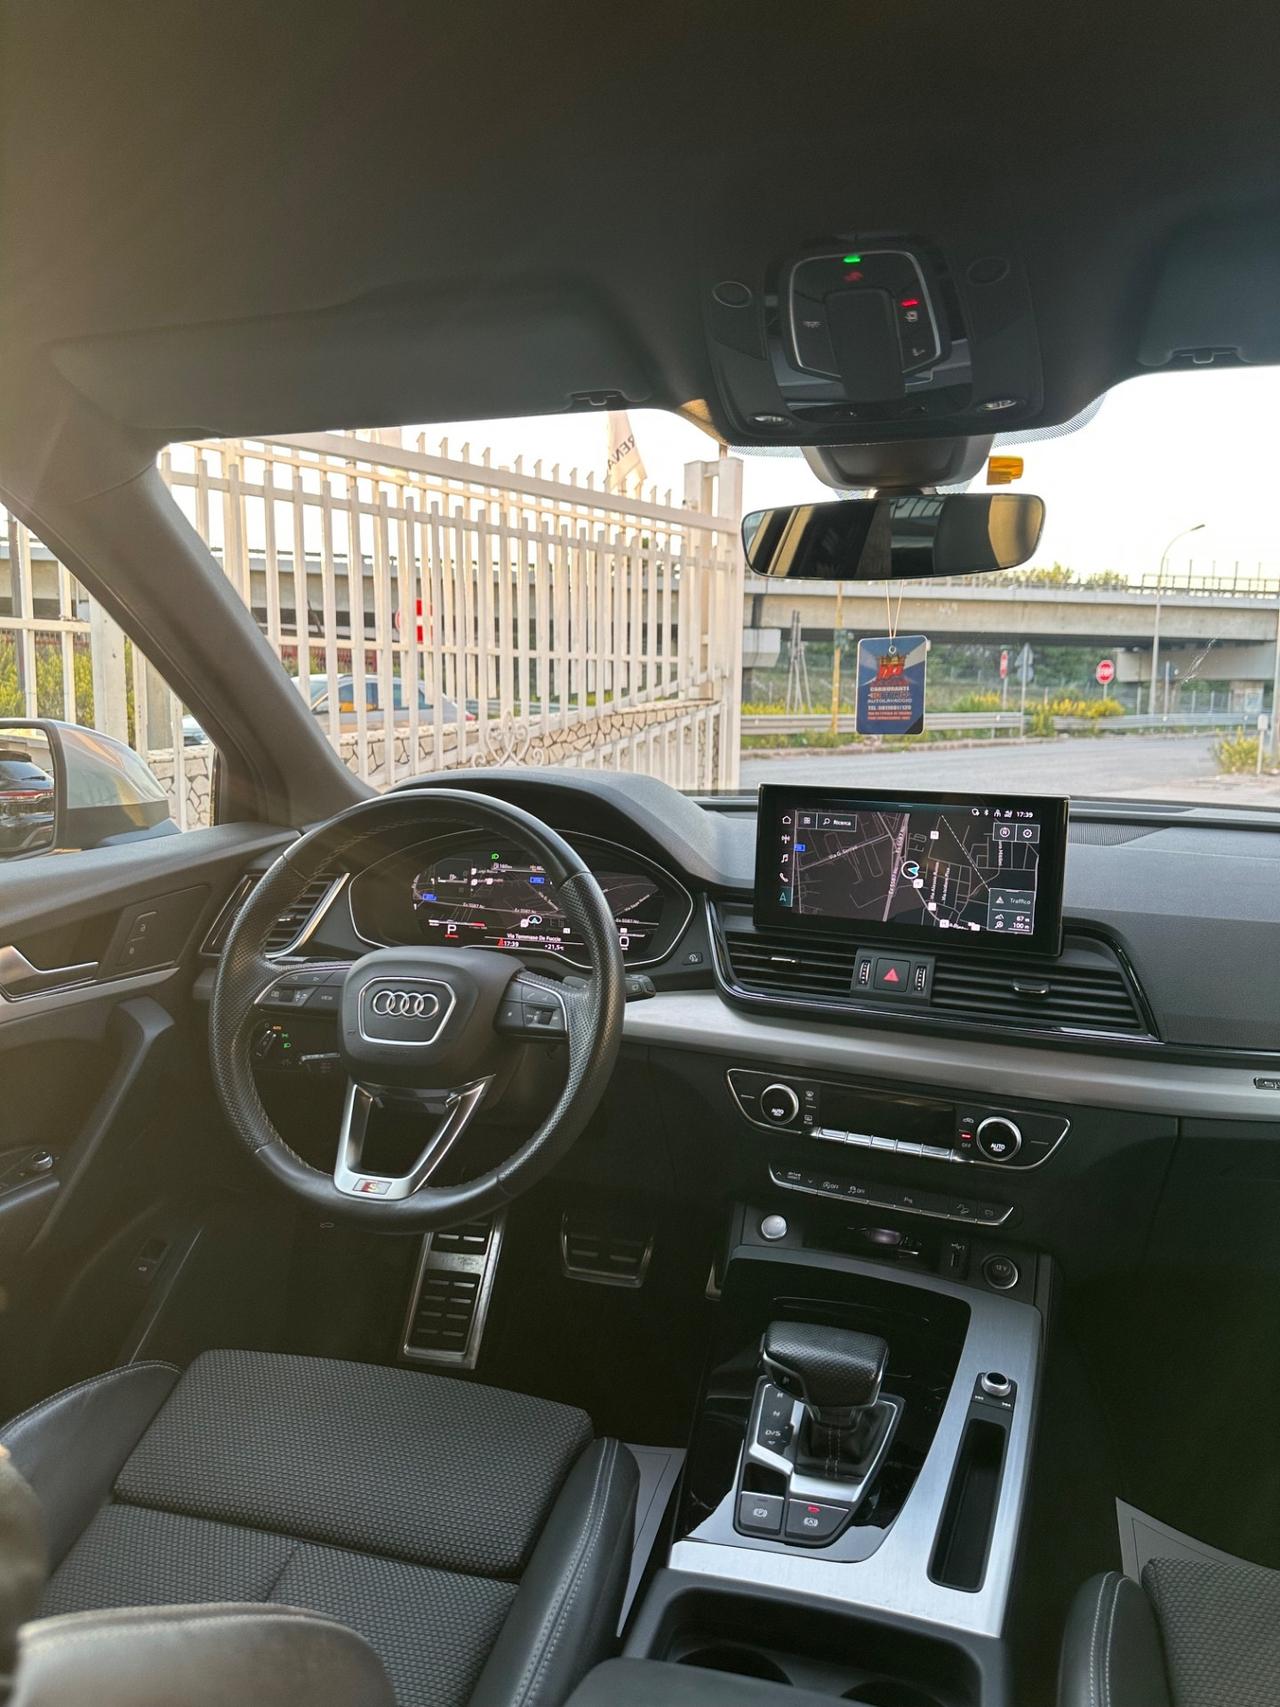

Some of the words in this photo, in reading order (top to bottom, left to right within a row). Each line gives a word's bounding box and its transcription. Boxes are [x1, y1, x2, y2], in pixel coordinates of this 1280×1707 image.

[1010, 897, 1031, 905] Traffico
[447, 925, 457, 934] P
[504, 940, 519, 948] 17:39
